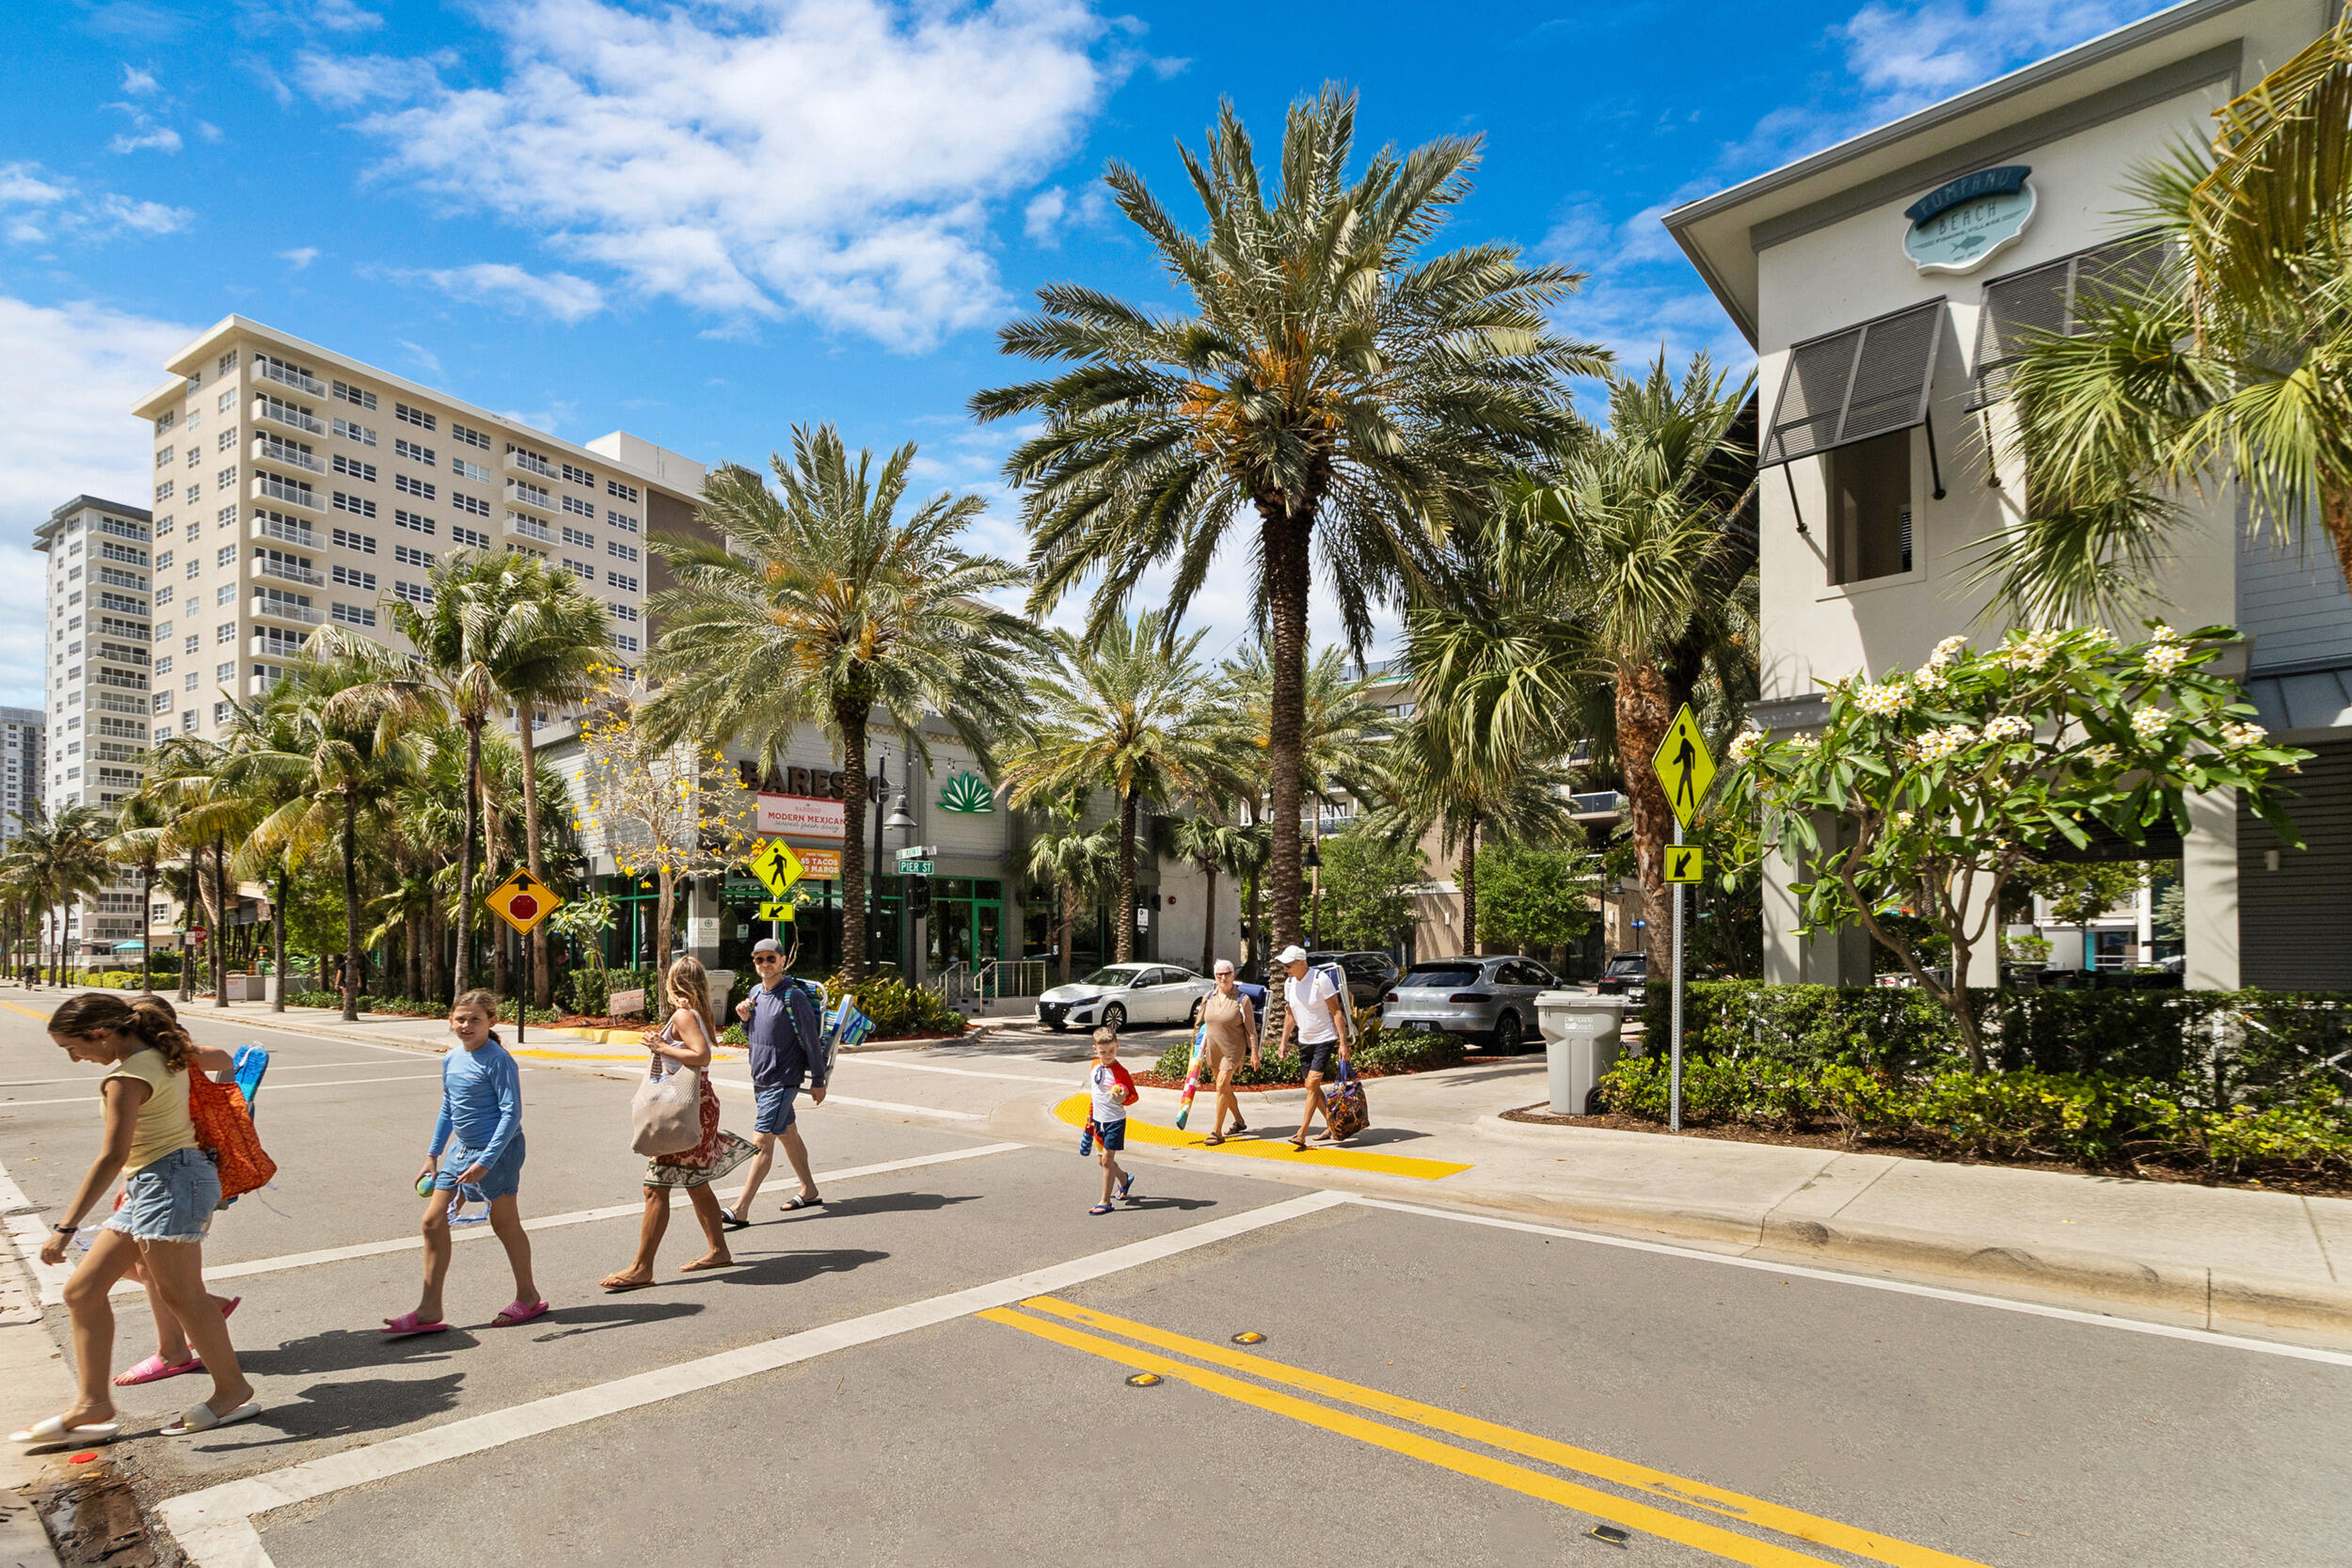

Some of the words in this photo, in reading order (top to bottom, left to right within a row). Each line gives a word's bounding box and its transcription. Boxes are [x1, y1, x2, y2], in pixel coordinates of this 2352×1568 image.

[1919, 169, 2011, 215] POMPANO
[1939, 200, 1996, 235] BEACH
[739, 760, 889, 804] BARESO
[768, 812, 804, 822] MODERN
[807, 816, 845, 826] MEXICAN
[811, 857, 838, 866] TACOS
[900, 862, 919, 872] PIER
[922, 863, 931, 873] ST
